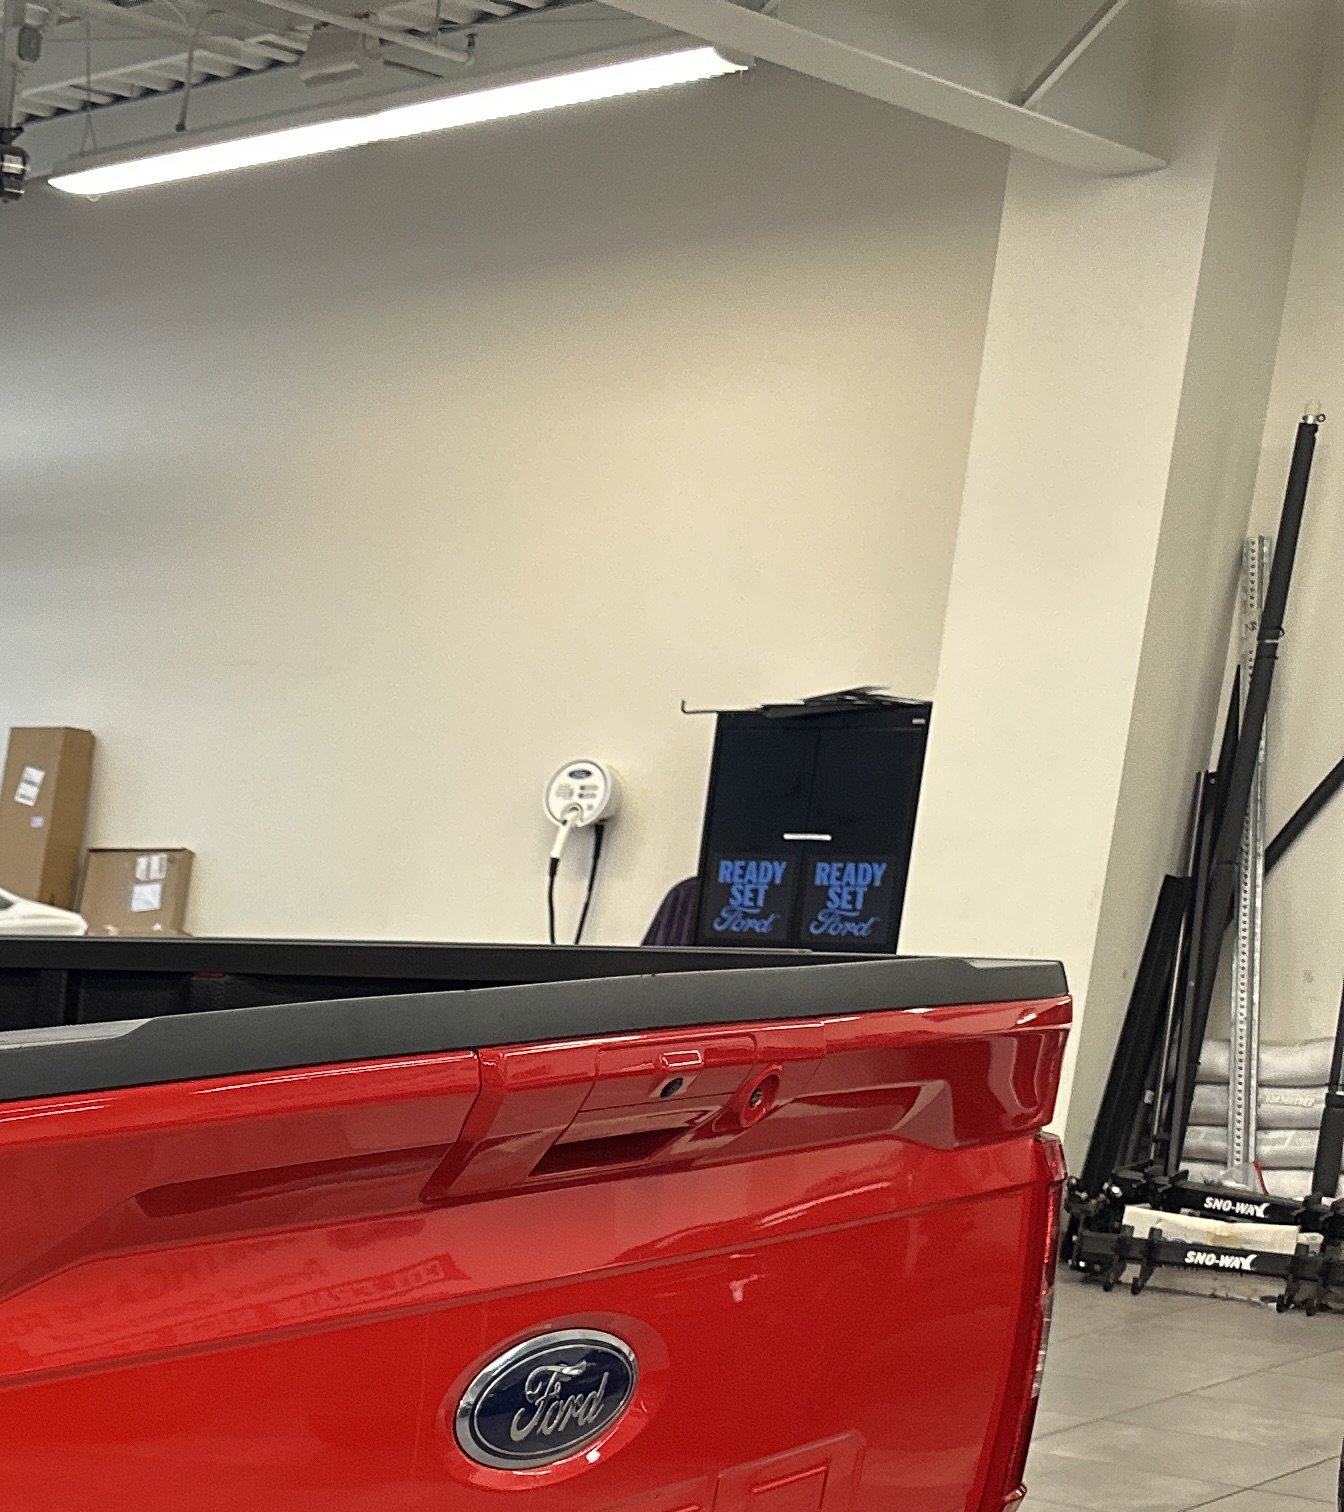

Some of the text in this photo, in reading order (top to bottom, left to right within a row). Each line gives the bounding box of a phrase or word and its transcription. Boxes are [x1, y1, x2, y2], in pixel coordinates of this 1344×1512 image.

[718, 860, 787, 884] READY
[814, 862, 887, 887] READY
[729, 884, 768, 907] SET
[826, 886, 868, 910] SET
[713, 905, 781, 934] Ford
[809, 907, 880, 936] Ford
[1204, 1197, 1270, 1218] SNO-WAY
[1185, 1251, 1257, 1271] SNO-WAY
[509, 1360, 609, 1442] Ford
